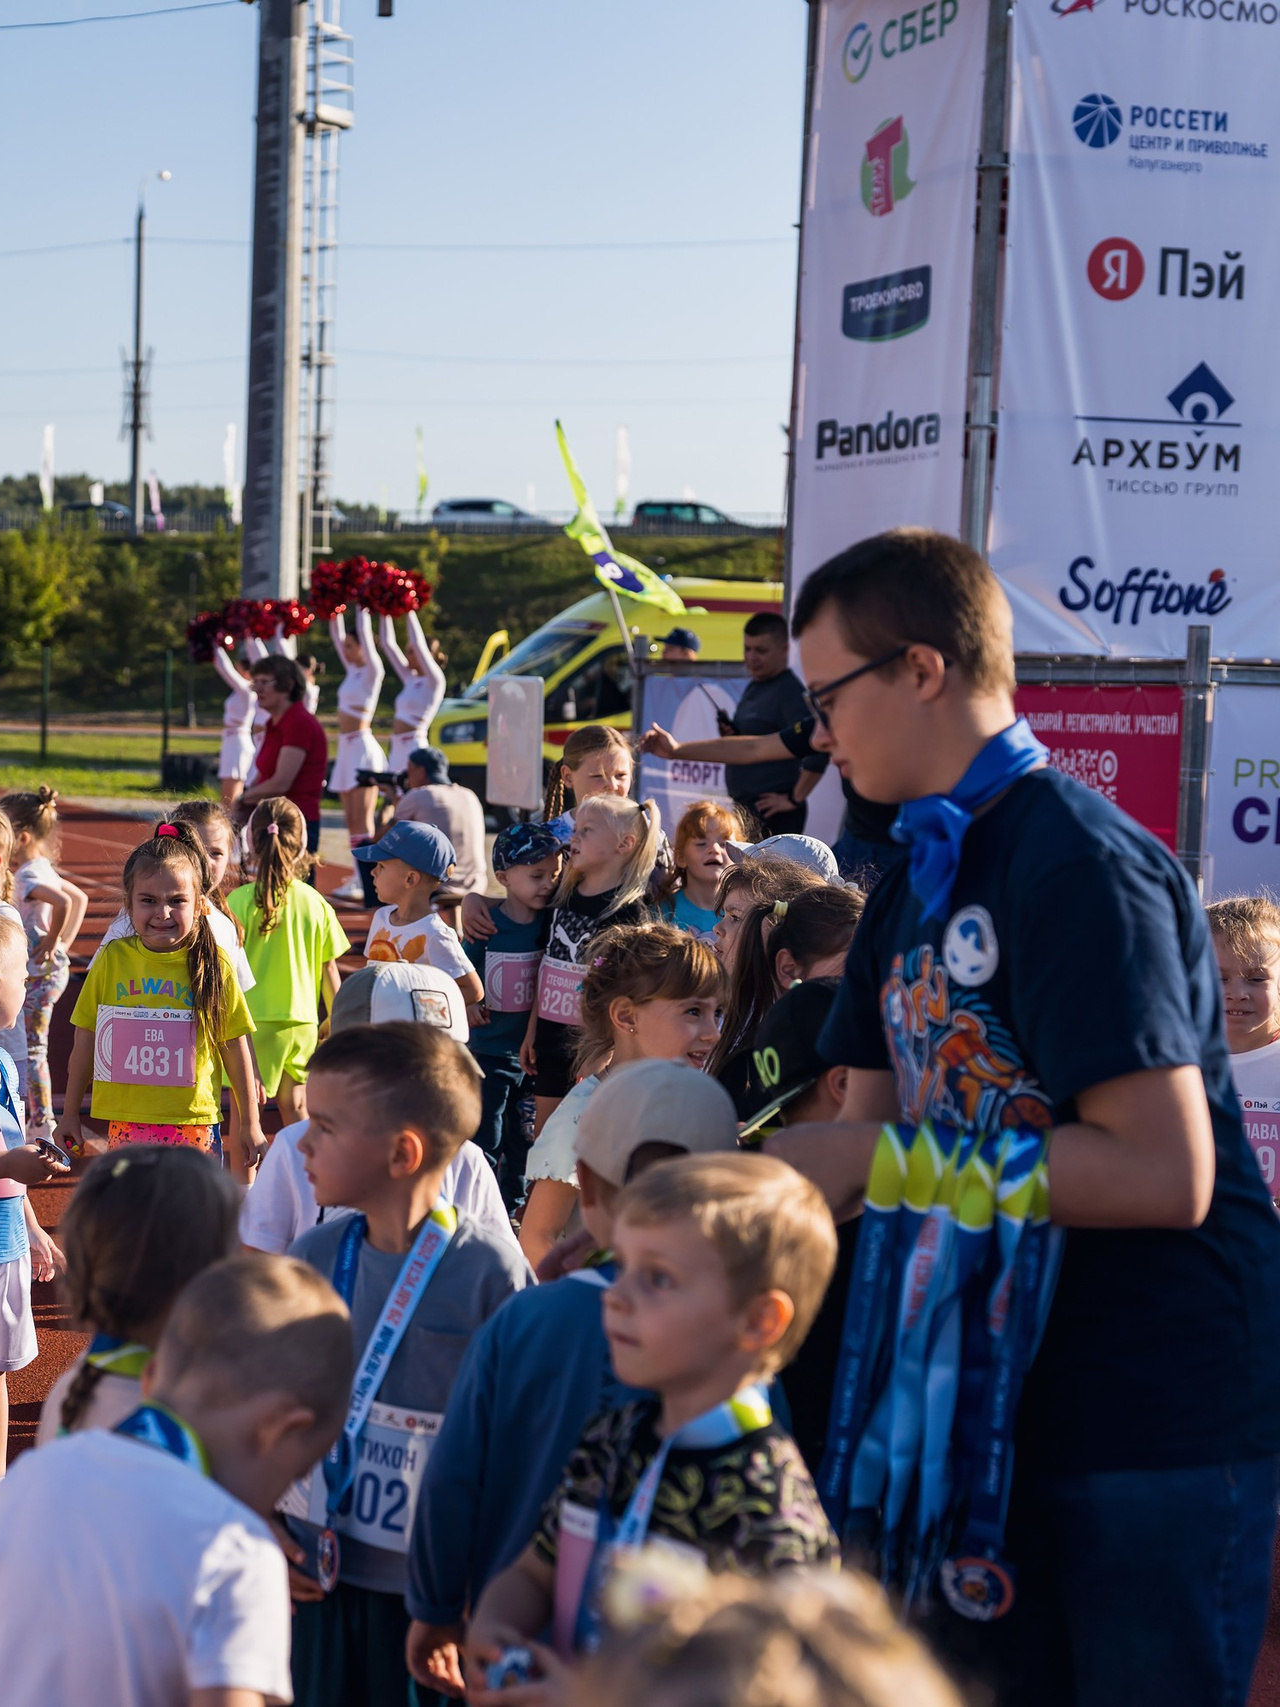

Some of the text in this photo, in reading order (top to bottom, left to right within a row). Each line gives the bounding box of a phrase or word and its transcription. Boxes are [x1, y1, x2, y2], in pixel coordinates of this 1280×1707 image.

[1124, 0, 1280, 25] РОСКОСМО
[879, 0, 959, 59] СБЕР
[1130, 105, 1228, 132] РОССЕТИ
[1129, 134, 1269, 158] ЦЕНТР И ПРИВОЛЖЬЕ
[1159, 247, 1246, 301] Пэй
[816, 410, 941, 460] Pandora
[1073, 436, 1242, 472] АРХБУМ
[1106, 478, 1239, 497] ТИССЬЮ ГРУПП
[1059, 555, 1233, 626] Soffione
[1134, 712, 1179, 736] УЧАСТВУЙ
[671, 760, 721, 786] СПОРТ
[116, 977, 194, 1008] ALWAYS
[546, 973, 583, 991] СТЕФАНИ
[144, 1029, 165, 1042] ЕВА
[124, 1045, 184, 1078] 4831
[1254, 1101, 1268, 1109] Пэй
